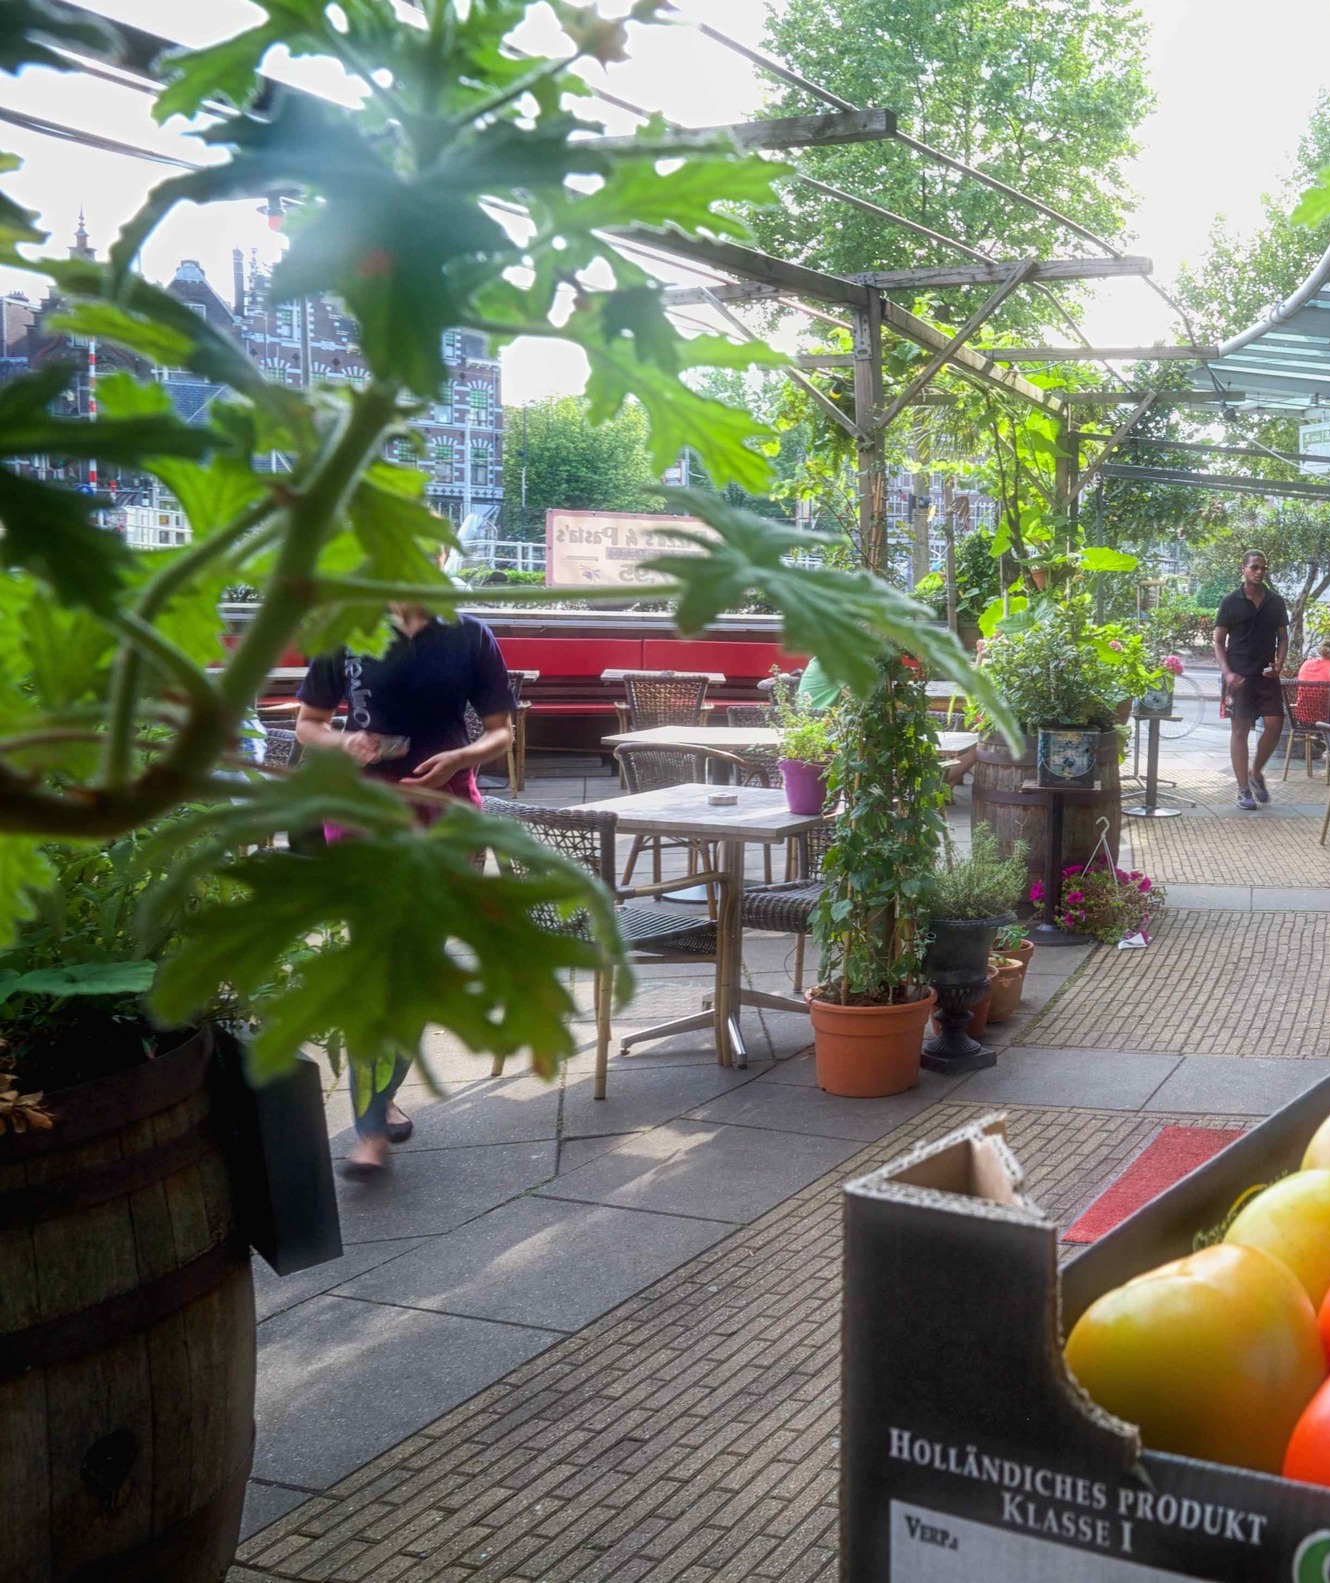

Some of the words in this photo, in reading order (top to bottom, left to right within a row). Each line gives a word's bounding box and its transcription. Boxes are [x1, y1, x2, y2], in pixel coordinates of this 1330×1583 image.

[888, 1427, 1107, 1510] HOLLÄNDICHES
[1117, 1489, 1269, 1546] PRODUKT
[1000, 1492, 1111, 1548] KLASSE
[1120, 1520, 1135, 1553] I
